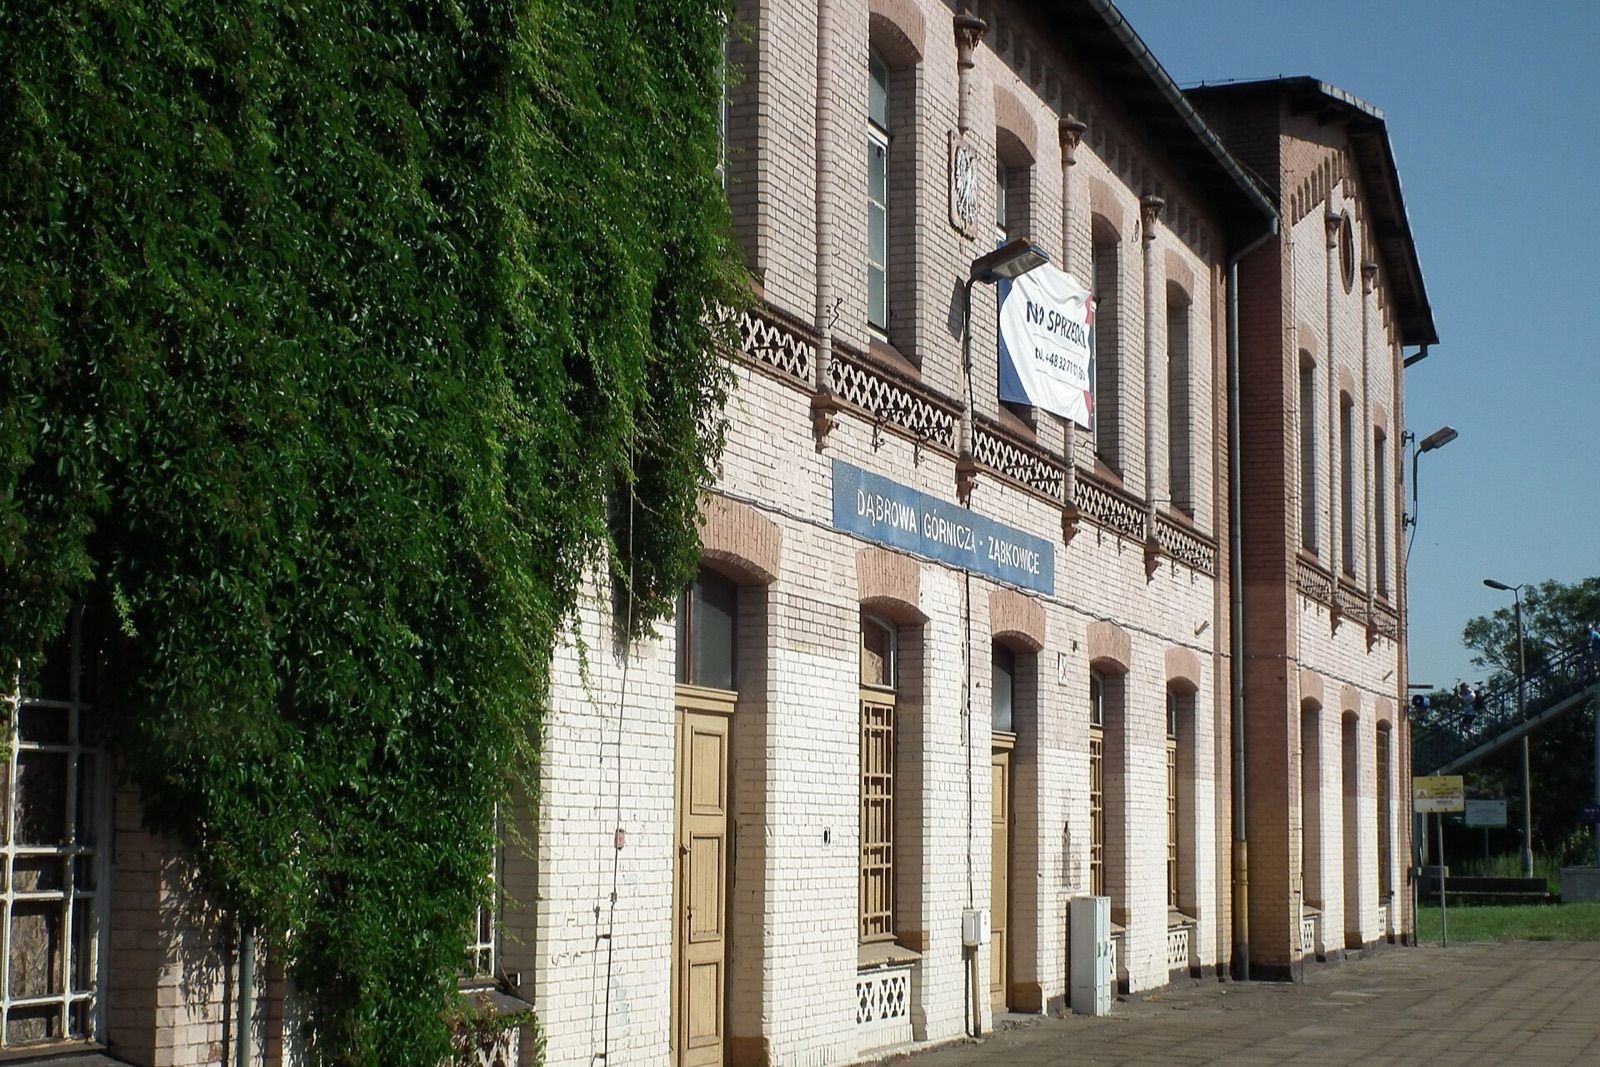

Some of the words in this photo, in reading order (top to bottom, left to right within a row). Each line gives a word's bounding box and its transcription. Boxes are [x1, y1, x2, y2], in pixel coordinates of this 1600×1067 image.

[857, 489, 917, 534] DĄBROWA
[924, 508, 976, 554] GÓRNICZA
[988, 536, 1040, 575] ZĄBKOWICE
